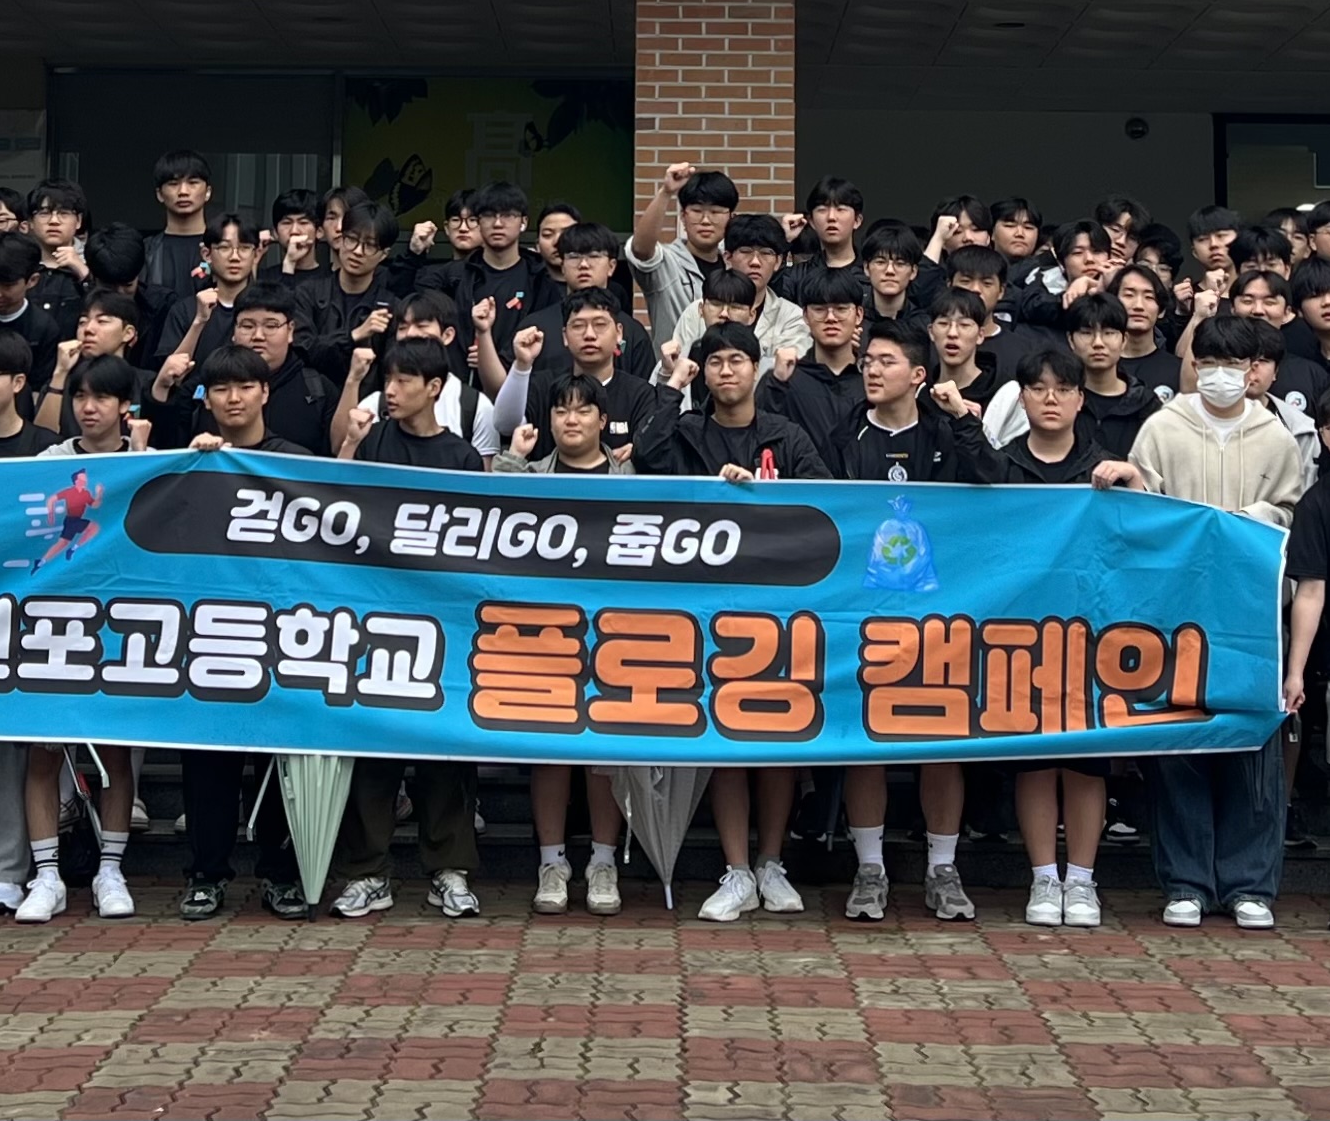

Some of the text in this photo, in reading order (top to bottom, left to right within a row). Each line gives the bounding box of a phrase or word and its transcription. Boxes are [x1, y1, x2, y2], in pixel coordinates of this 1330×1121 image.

[226, 488, 742, 568] 걷GO, 달리GO, 줍GO
[472, 604, 817, 733] 플로깅
[862, 617, 1215, 737] 캠페인
